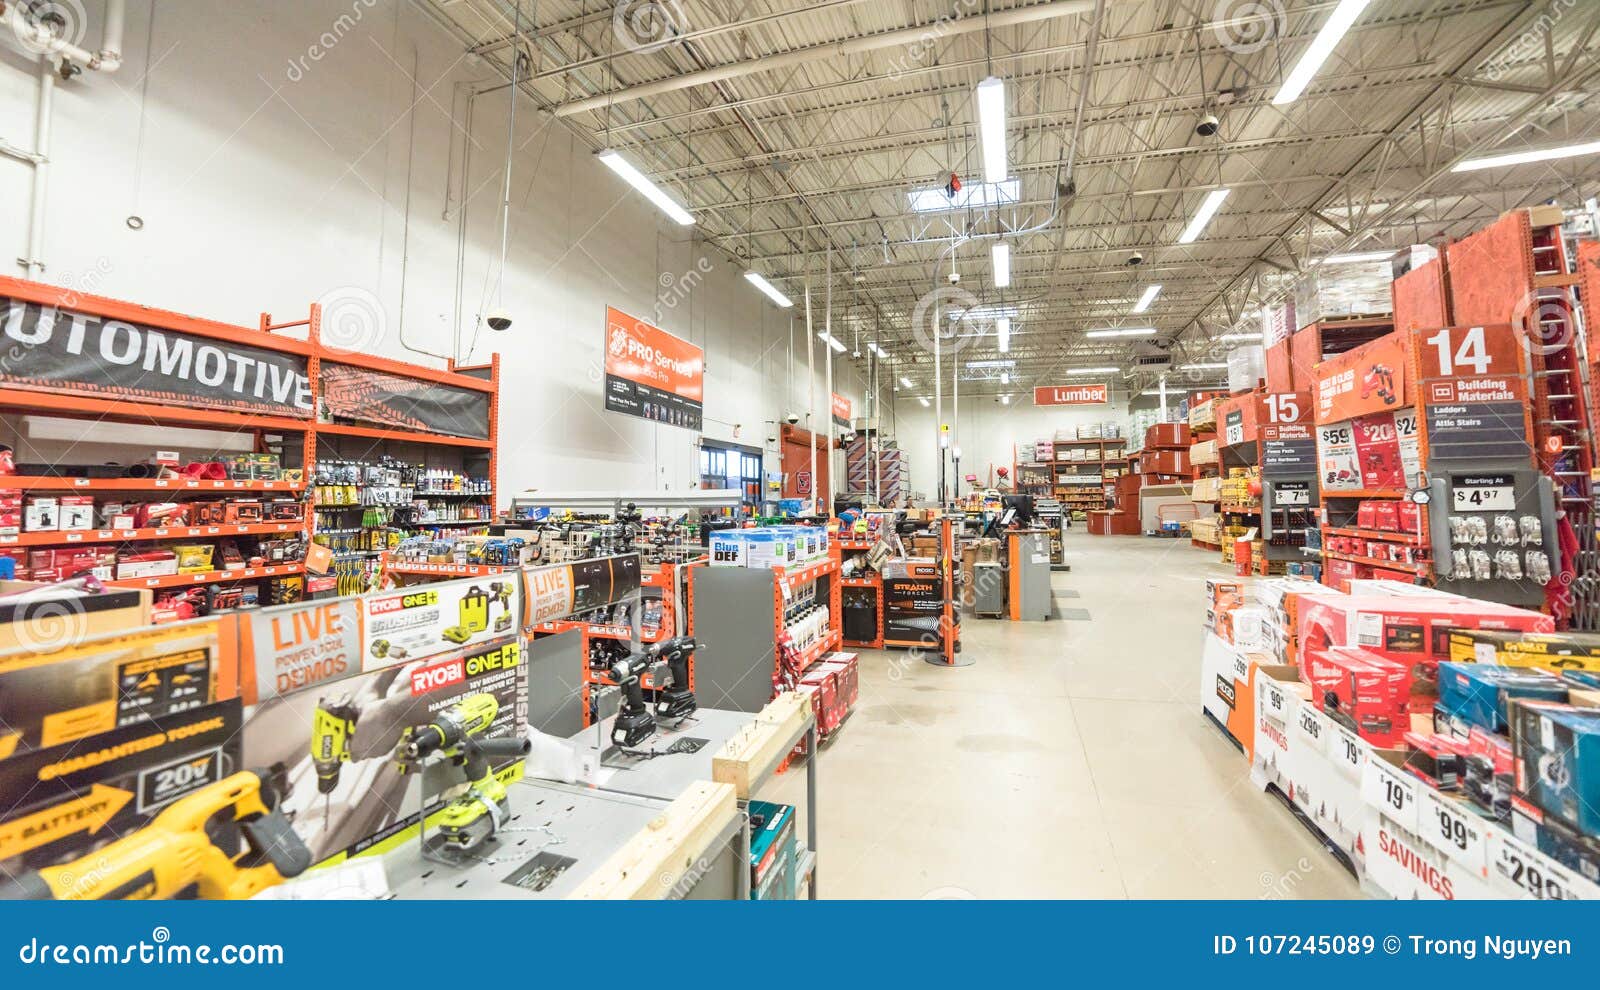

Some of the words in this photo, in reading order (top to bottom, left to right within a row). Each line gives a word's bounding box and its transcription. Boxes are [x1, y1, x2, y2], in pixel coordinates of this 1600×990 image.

[628, 338, 654, 363] PRO
[654, 350, 693, 379] Services
[1427, 326, 1492, 376] 14
[1054, 386, 1104, 402] Lumber
[1457, 379, 1507, 392] Building
[1458, 391, 1515, 403] Materials
[1262, 393, 1299, 423] 15
[1434, 406, 1467, 414] Ladders
[1279, 425, 1306, 433] Building
[1435, 419, 1455, 427] Attic
[1456, 418, 1482, 427] Stairs
[1464, 477, 1494, 486] Starting
[715, 543, 739, 552] Blue
[714, 552, 739, 562] DEF
[533, 568, 565, 596] LIVE
[893, 583, 933, 591] STEALTH
[371, 599, 402, 614] RYOBI
[535, 600, 566, 622] DEMOS
[271, 601, 344, 651] LIVE
[276, 654, 347, 693] DEMOS
[412, 662, 462, 692] RYOBI
[483, 669, 515, 687] BRUSHLESS
[1260, 718, 1288, 752] SAVINGS
[1379, 829, 1454, 900] SAVINGS
